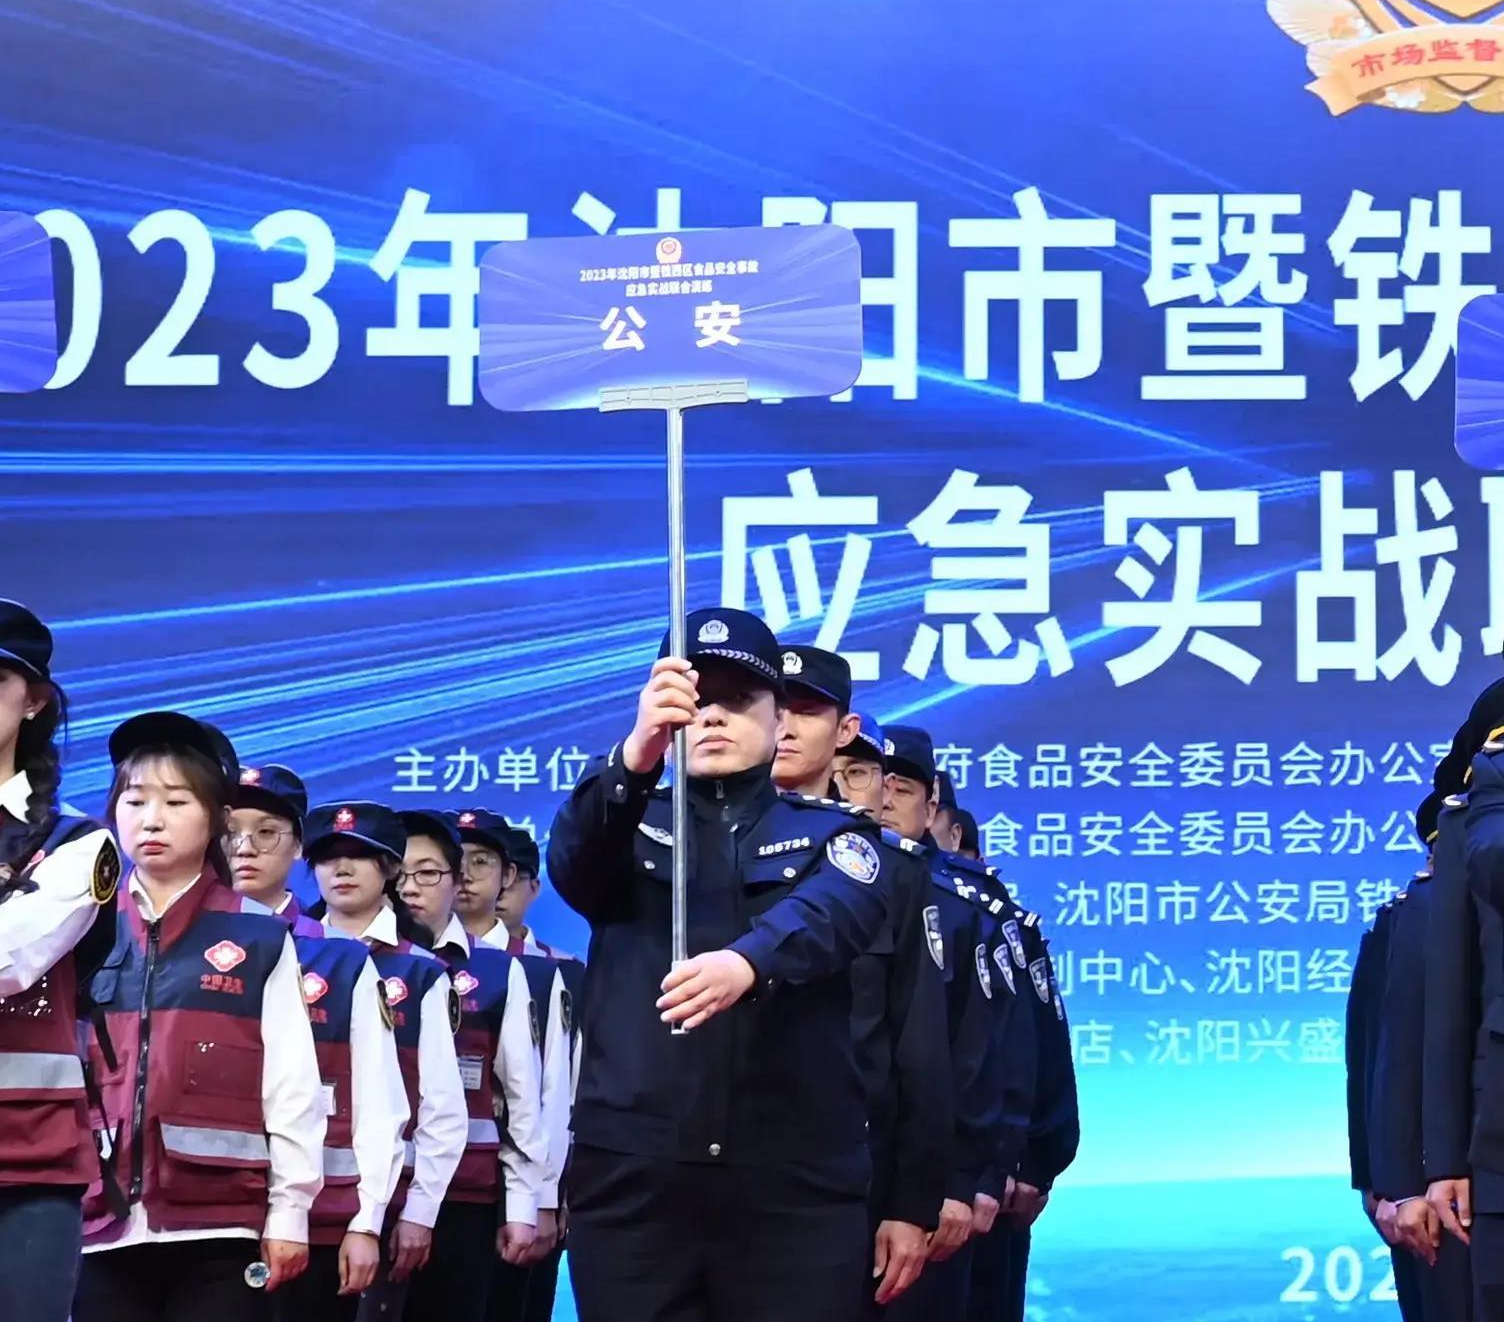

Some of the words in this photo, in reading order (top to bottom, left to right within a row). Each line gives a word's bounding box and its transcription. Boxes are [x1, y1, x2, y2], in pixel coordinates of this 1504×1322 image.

[599, 300, 742, 352] 公安
[391, 746, 591, 793] 主办单位
